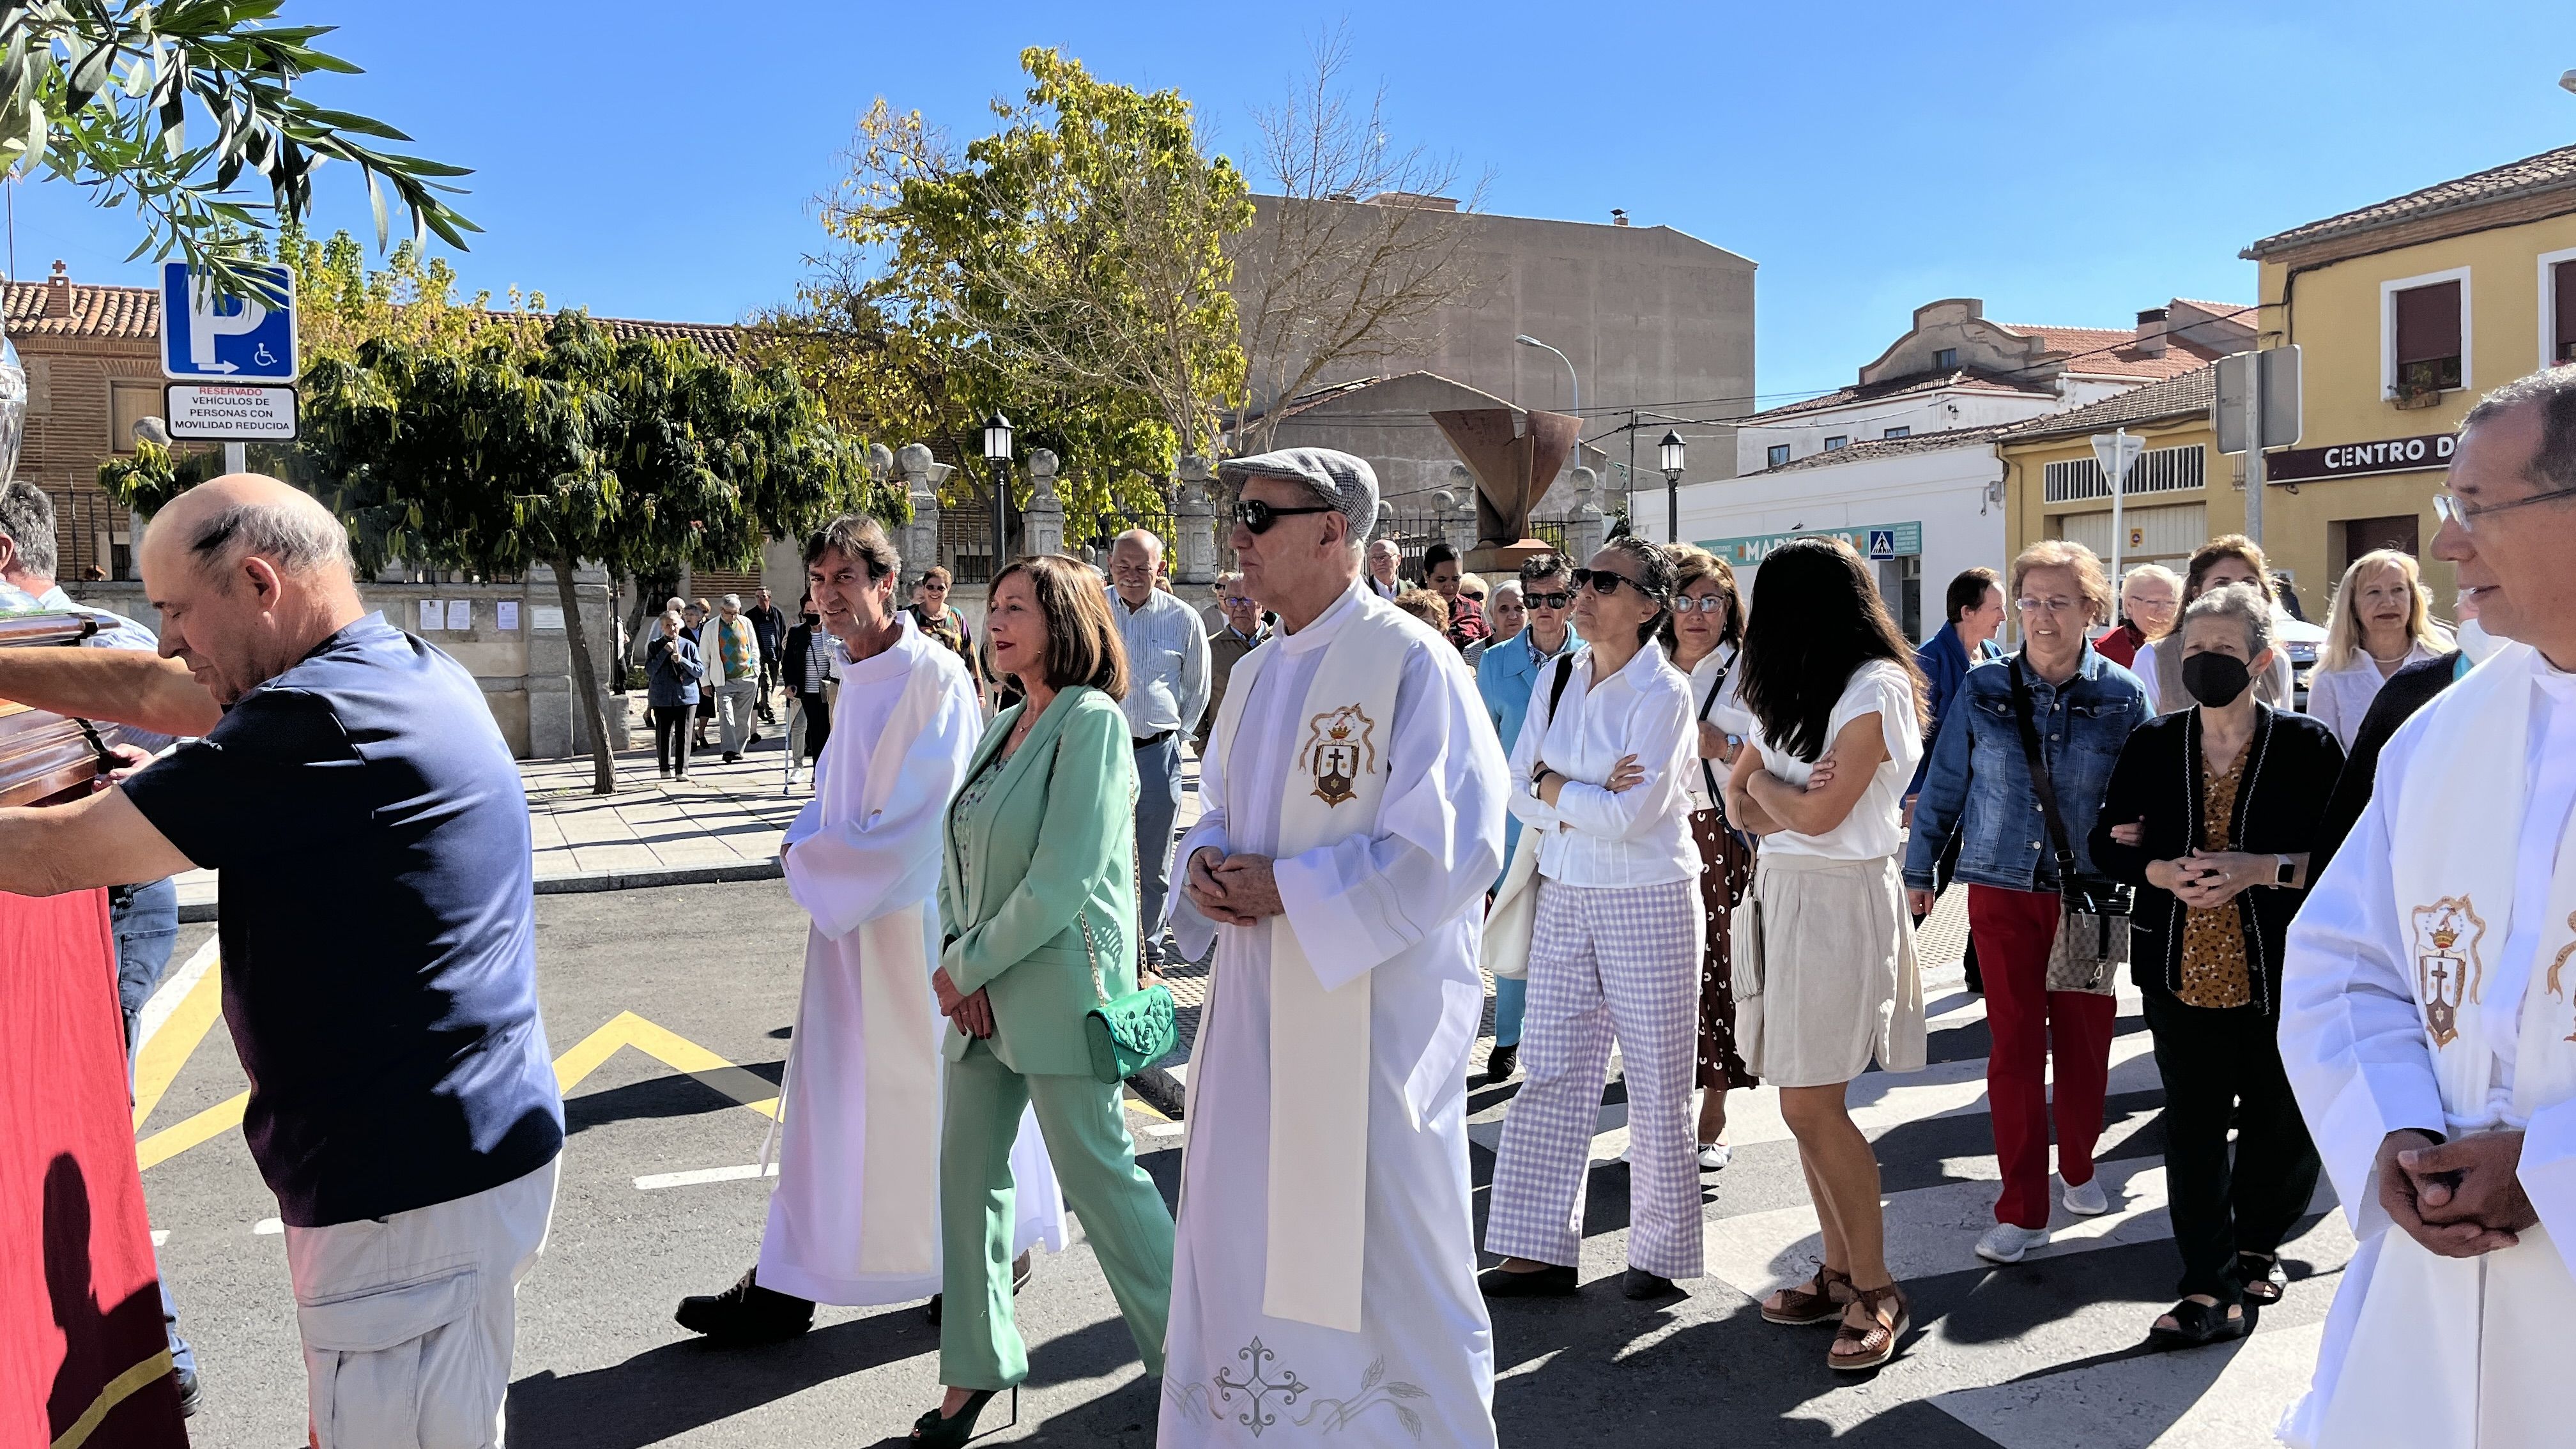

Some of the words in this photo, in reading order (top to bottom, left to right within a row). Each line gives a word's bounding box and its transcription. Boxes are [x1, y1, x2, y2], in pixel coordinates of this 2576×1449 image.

[188, 275, 266, 364] P
[199, 387, 263, 395] RESERVADO
[192, 397, 252, 406] VEHÍCULOS
[190, 409, 247, 417] PERSONAS
[175, 421, 233, 429] MOVILIDAD
[236, 422, 289, 430] REDUCIDA
[2324, 439, 2425, 469] CENTRO
[2437, 436, 2455, 457] D
